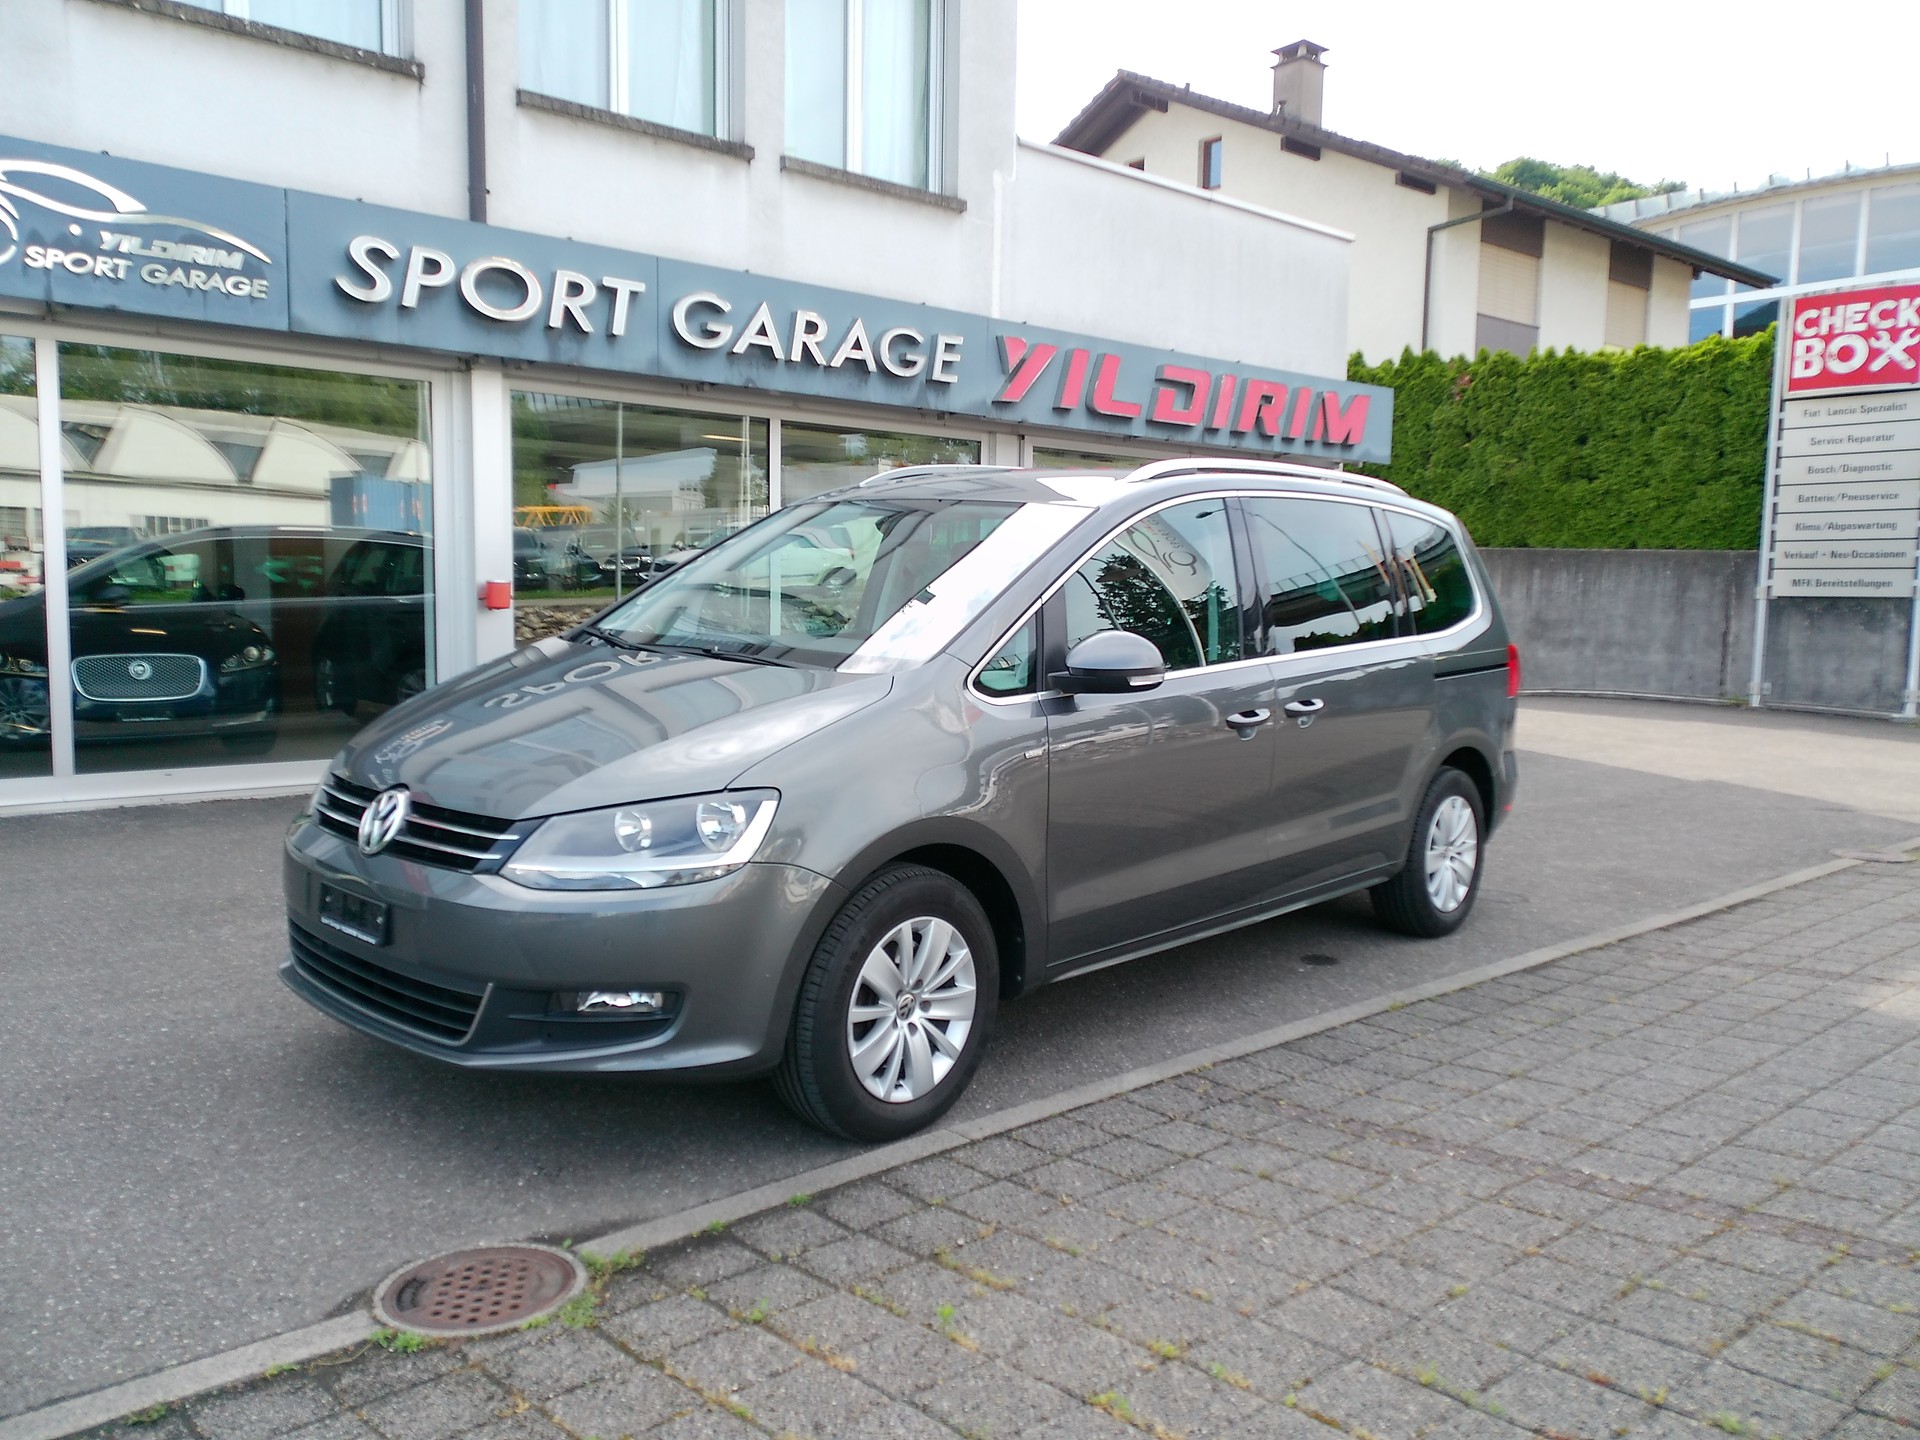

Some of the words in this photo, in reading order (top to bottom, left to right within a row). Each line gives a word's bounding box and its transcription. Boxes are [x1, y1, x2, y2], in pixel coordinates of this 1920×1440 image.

[99, 230, 245, 271] YILDIRIM
[24, 245, 133, 281] SPORT
[140, 263, 269, 300] GARAGE
[1795, 297, 1920, 338] CHECK
[334, 235, 645, 336] SPORT
[671, 292, 964, 384] GARAGE
[993, 334, 1371, 446] YILDIRIM
[1792, 327, 1920, 379] BOX
[1860, 403, 1908, 413] Spezialist
[1810, 436, 1844, 446] Service
[1847, 434, 1896, 444] Reparatur
[1784, 551, 1819, 559] Verkauf
[1815, 579, 1893, 589] Bereitstellungen
